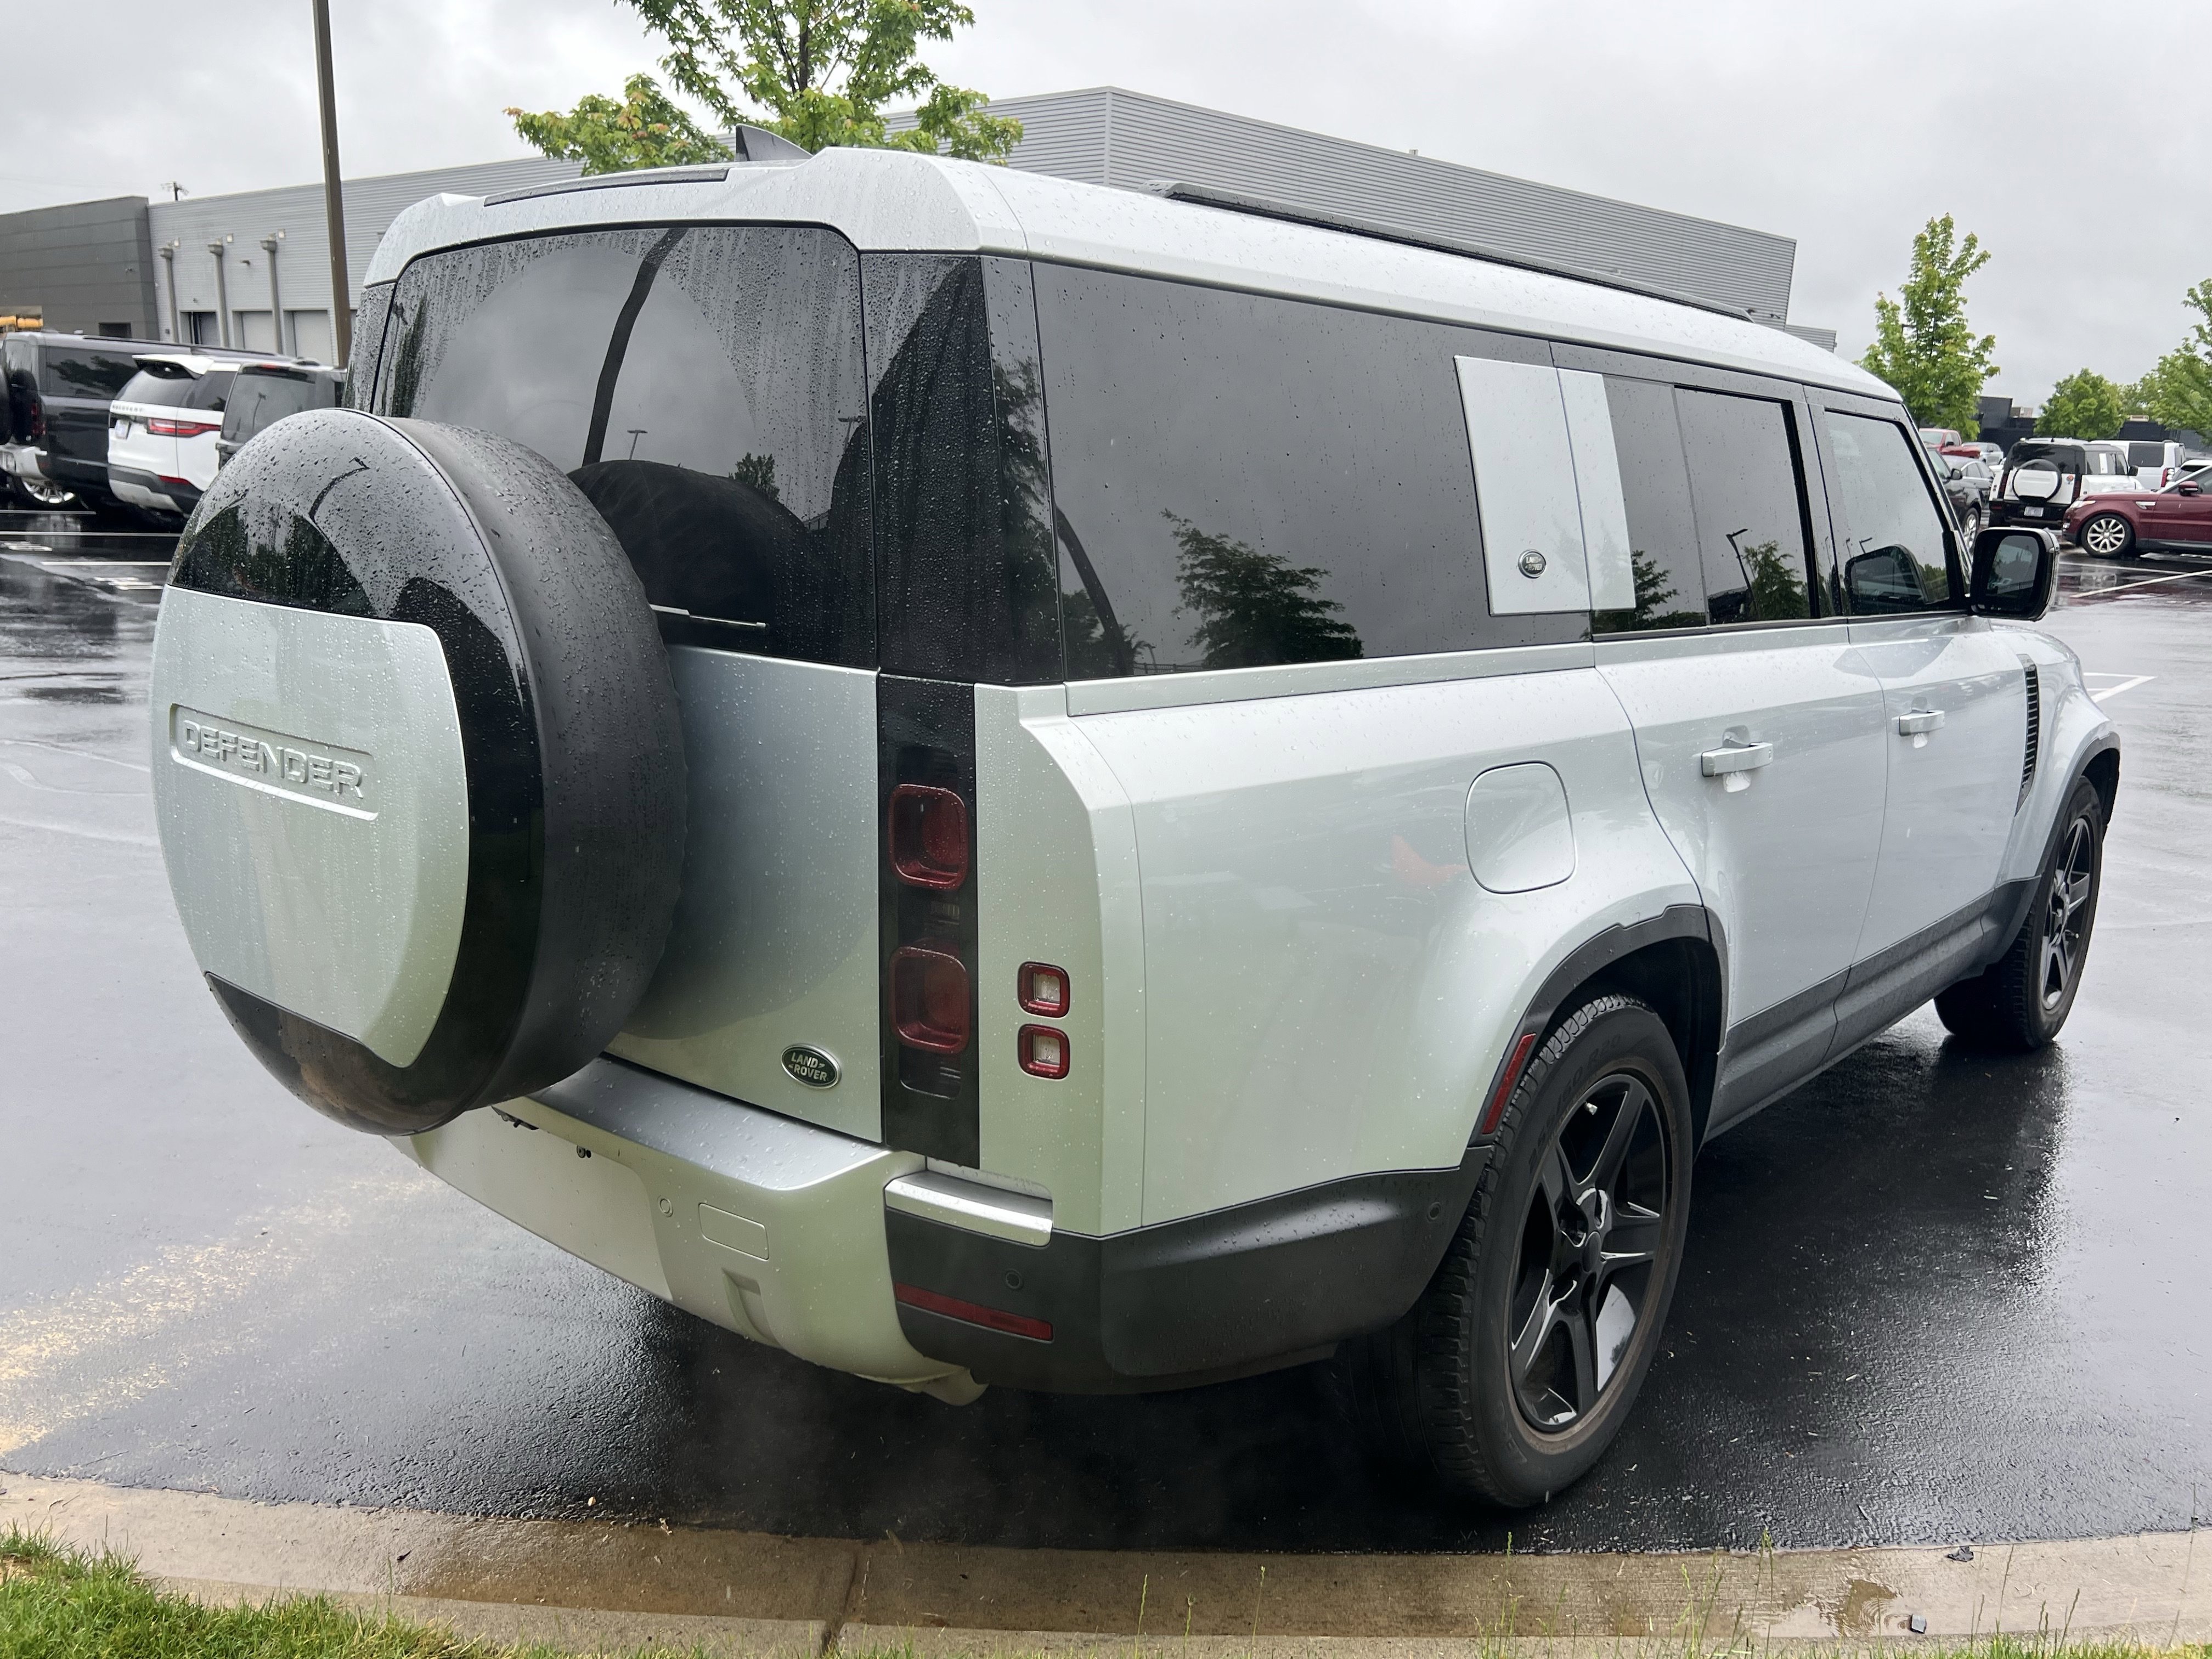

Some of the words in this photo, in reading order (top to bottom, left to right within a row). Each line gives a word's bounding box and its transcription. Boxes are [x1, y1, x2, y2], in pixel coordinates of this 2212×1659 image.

[183, 719, 364, 799] DEFENDER
[791, 1052, 819, 1068] LAND
[793, 1064, 827, 1081] ROVER
